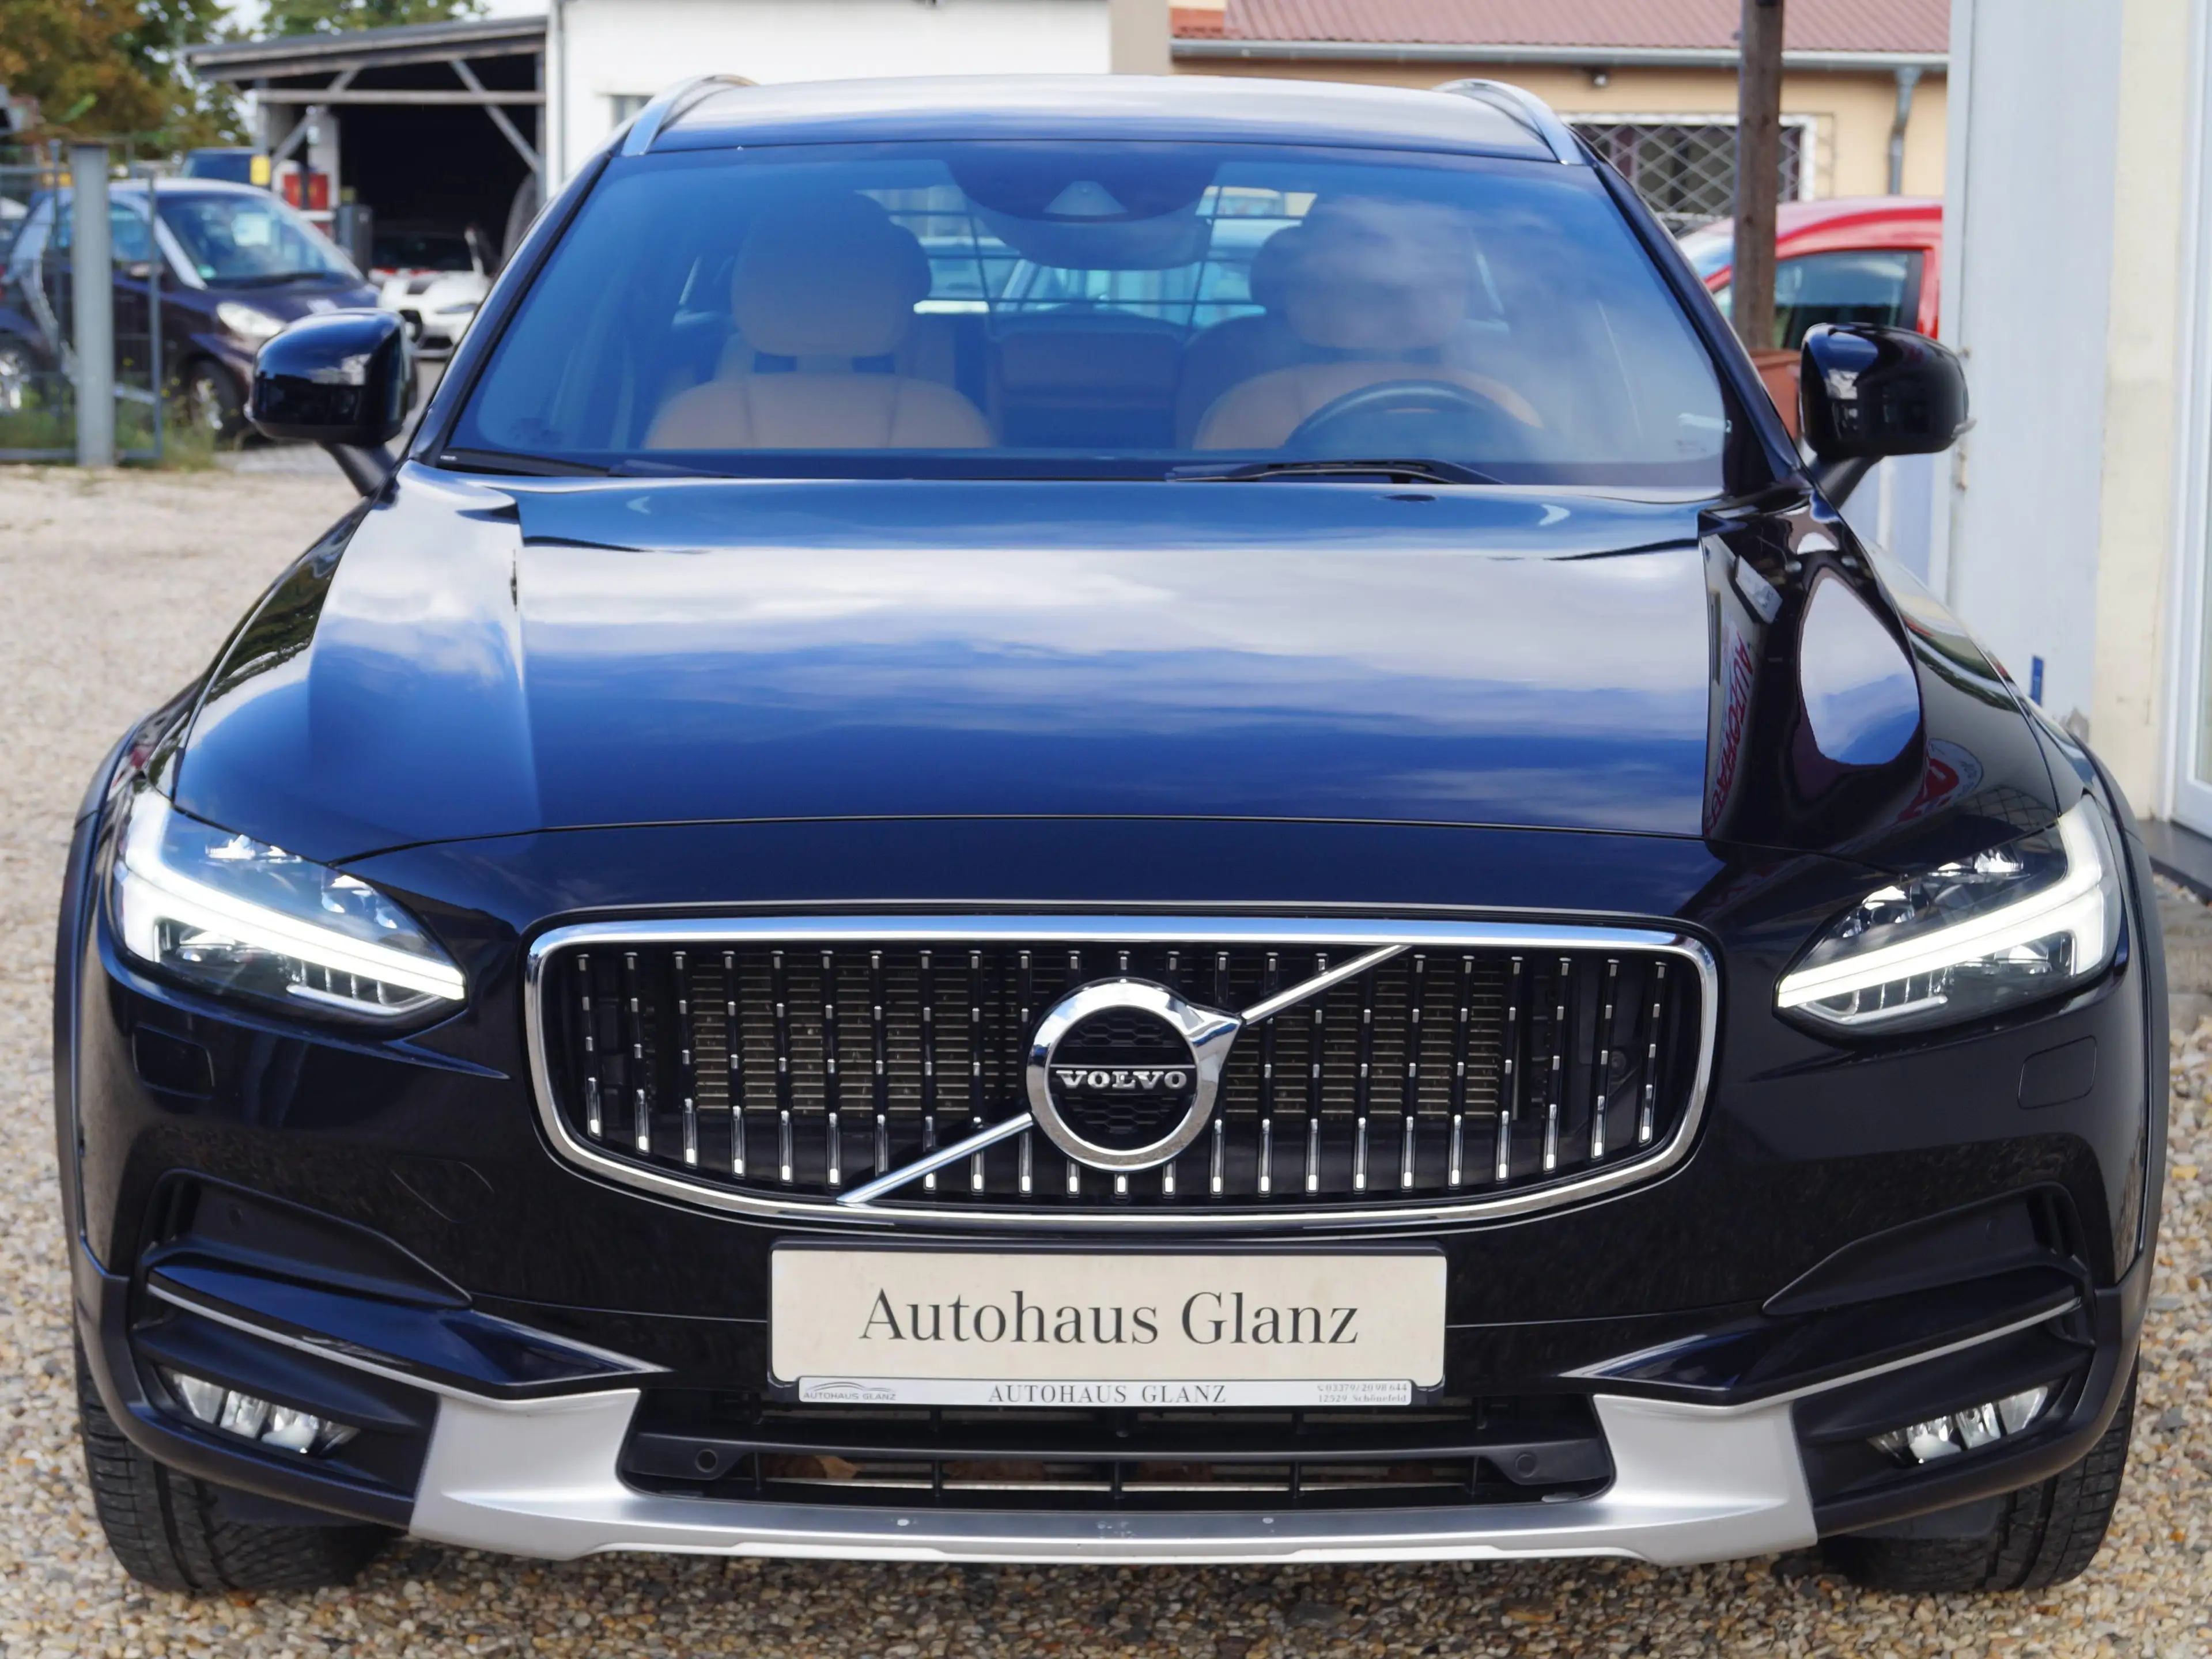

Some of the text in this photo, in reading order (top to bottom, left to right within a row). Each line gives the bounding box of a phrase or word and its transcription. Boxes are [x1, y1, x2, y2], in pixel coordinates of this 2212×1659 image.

[1056, 1070, 1187, 1089] VOLVO
[859, 1287, 1358, 1344] Autohaus Glanz
[803, 1392, 897, 1401] AUTOHAUS GLANZ
[988, 1385, 1227, 1403] AUTOHAUS GLANZ
[1319, 1394, 1406, 1403] 12529 Schönefeld
